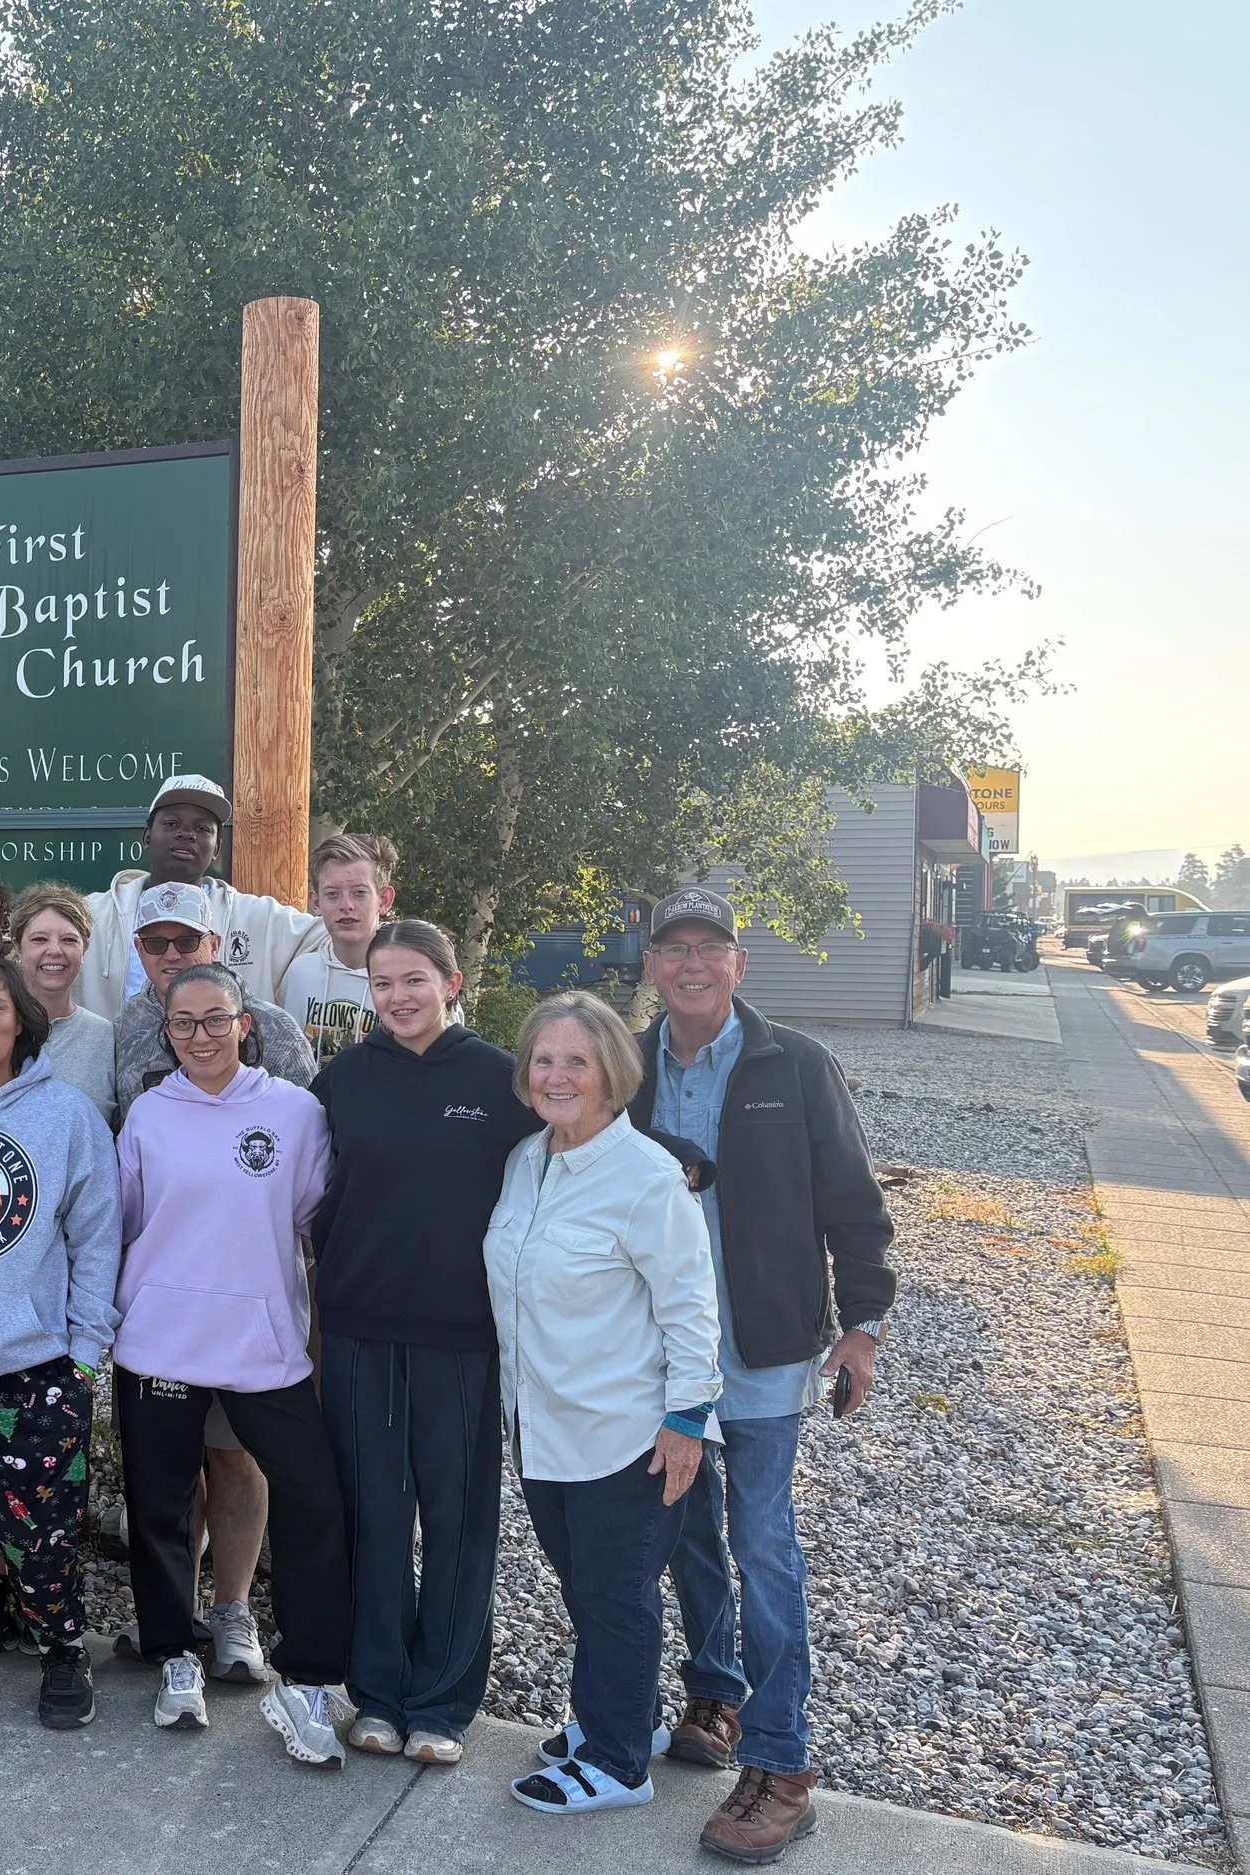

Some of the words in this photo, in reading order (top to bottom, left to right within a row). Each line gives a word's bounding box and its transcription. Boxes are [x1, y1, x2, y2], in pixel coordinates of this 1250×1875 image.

[16, 639, 206, 698] Church
[27, 748, 183, 783] WELCOME
[971, 788, 1012, 799] TONE
[976, 801, 1006, 810] OURS
[752, 1100, 784, 1109] Columbia
[151, 1389, 188, 1400] UNLIMITED
